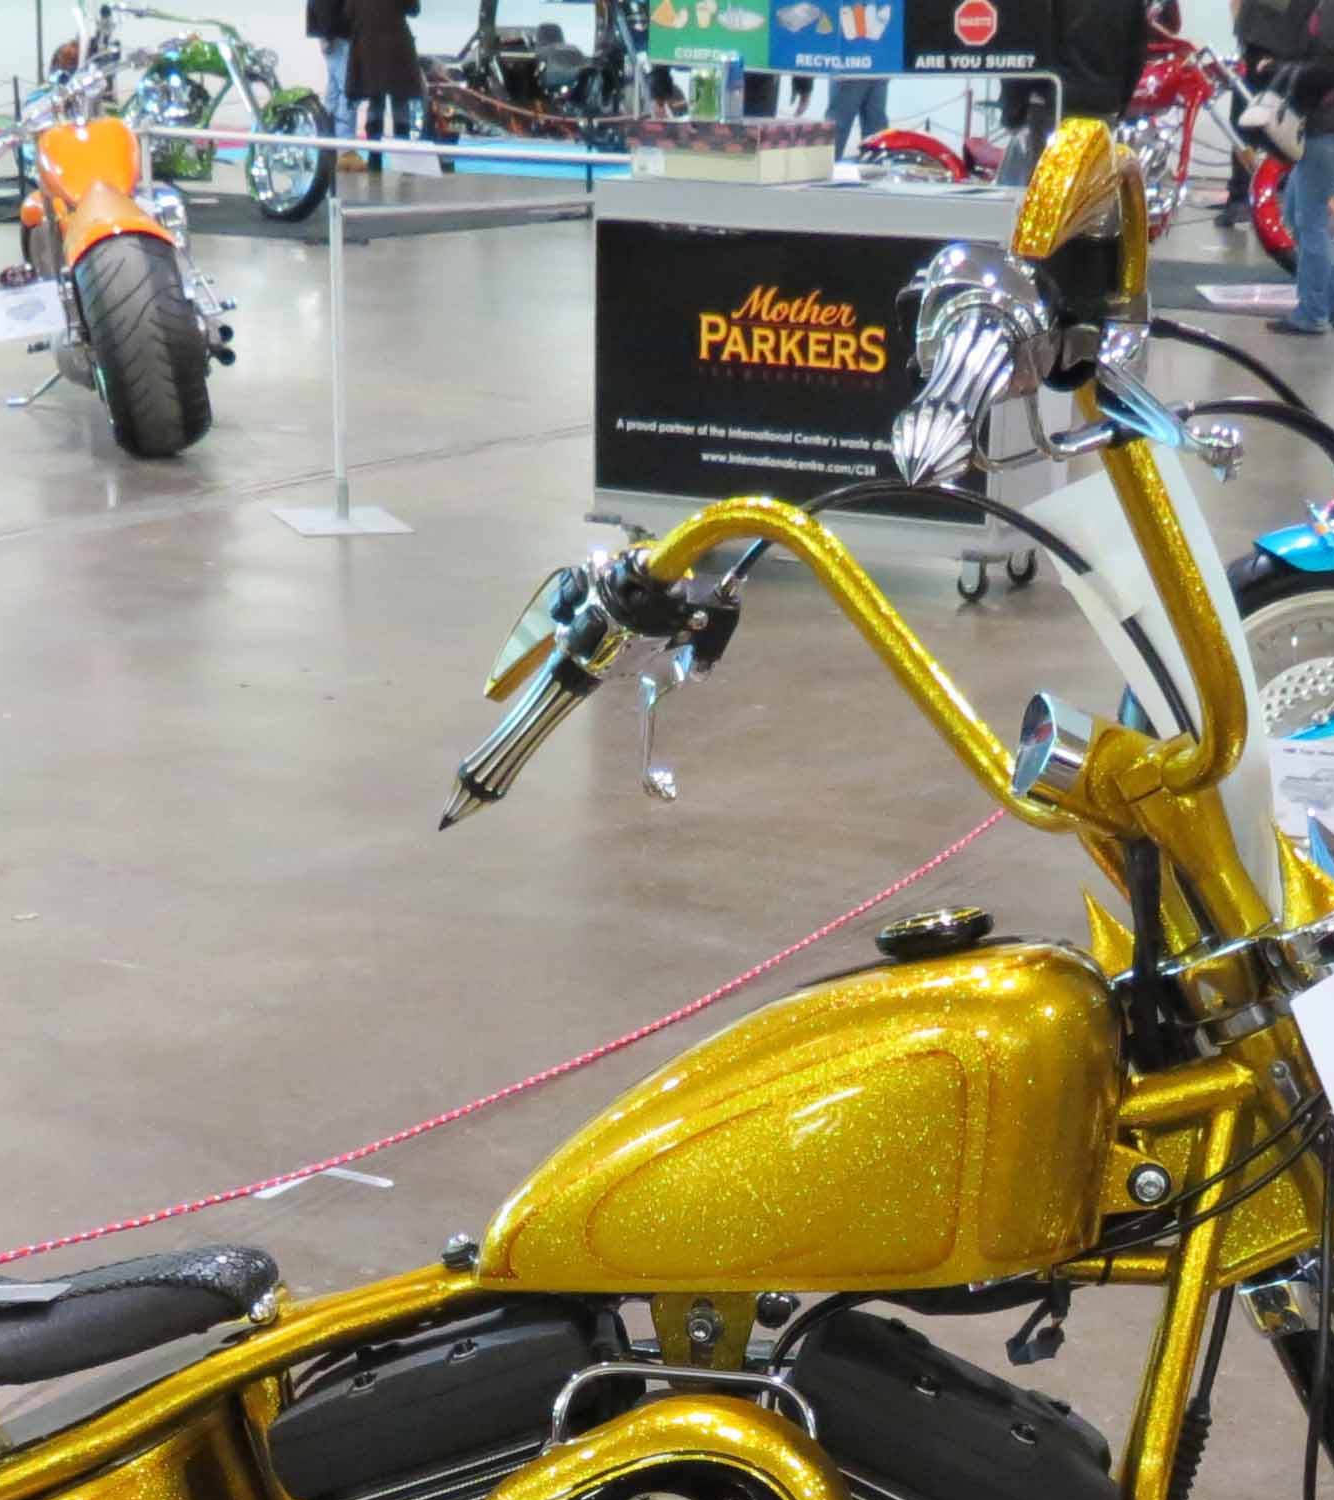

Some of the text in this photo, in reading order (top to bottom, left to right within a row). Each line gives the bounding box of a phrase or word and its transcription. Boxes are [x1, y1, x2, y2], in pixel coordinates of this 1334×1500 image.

[795, 53, 872, 69] RECYCLING
[914, 54, 1035, 69] ARE YOU SURE?
[730, 284, 857, 328] Mother
[698, 311, 887, 374] PARKERS
[616, 417, 625, 429] A
[626, 420, 657, 432] proud
[658, 422, 695, 434] partner
[697, 424, 708, 436] of
[709, 425, 726, 437] the
[794, 432, 838, 447] Centre's
[839, 437, 870, 449] waste
